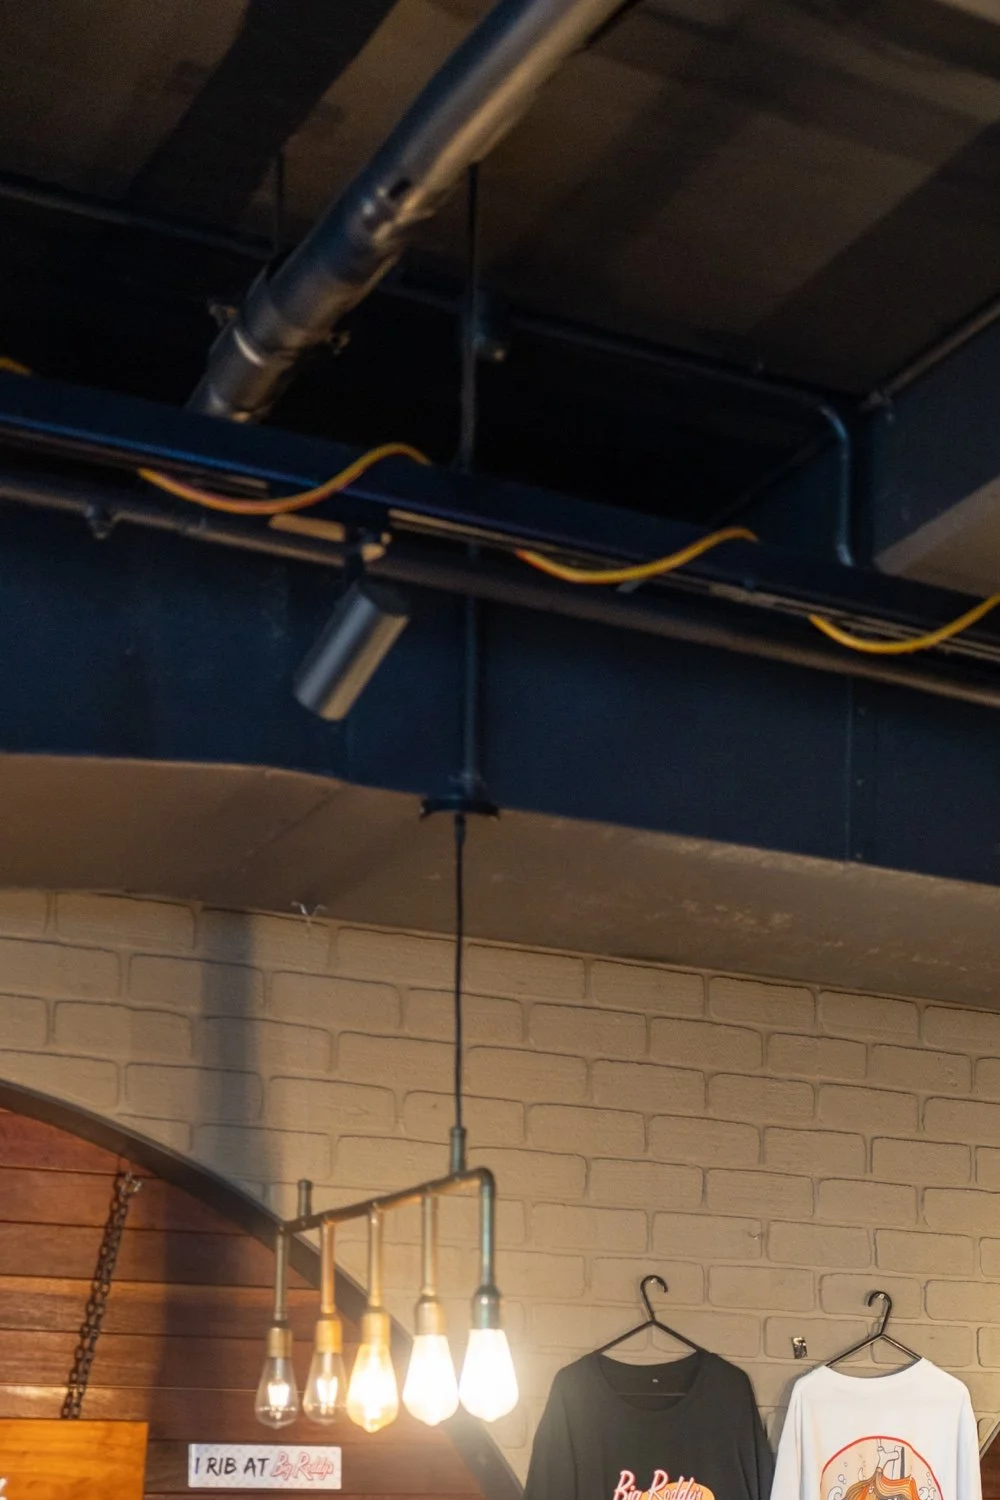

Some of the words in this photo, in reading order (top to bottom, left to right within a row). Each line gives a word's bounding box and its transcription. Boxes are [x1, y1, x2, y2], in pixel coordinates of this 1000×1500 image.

[194, 1457, 201, 1475] I
[206, 1457, 237, 1476] RIB
[243, 1457, 270, 1478] AT
[271, 1451, 293, 1481] Big
